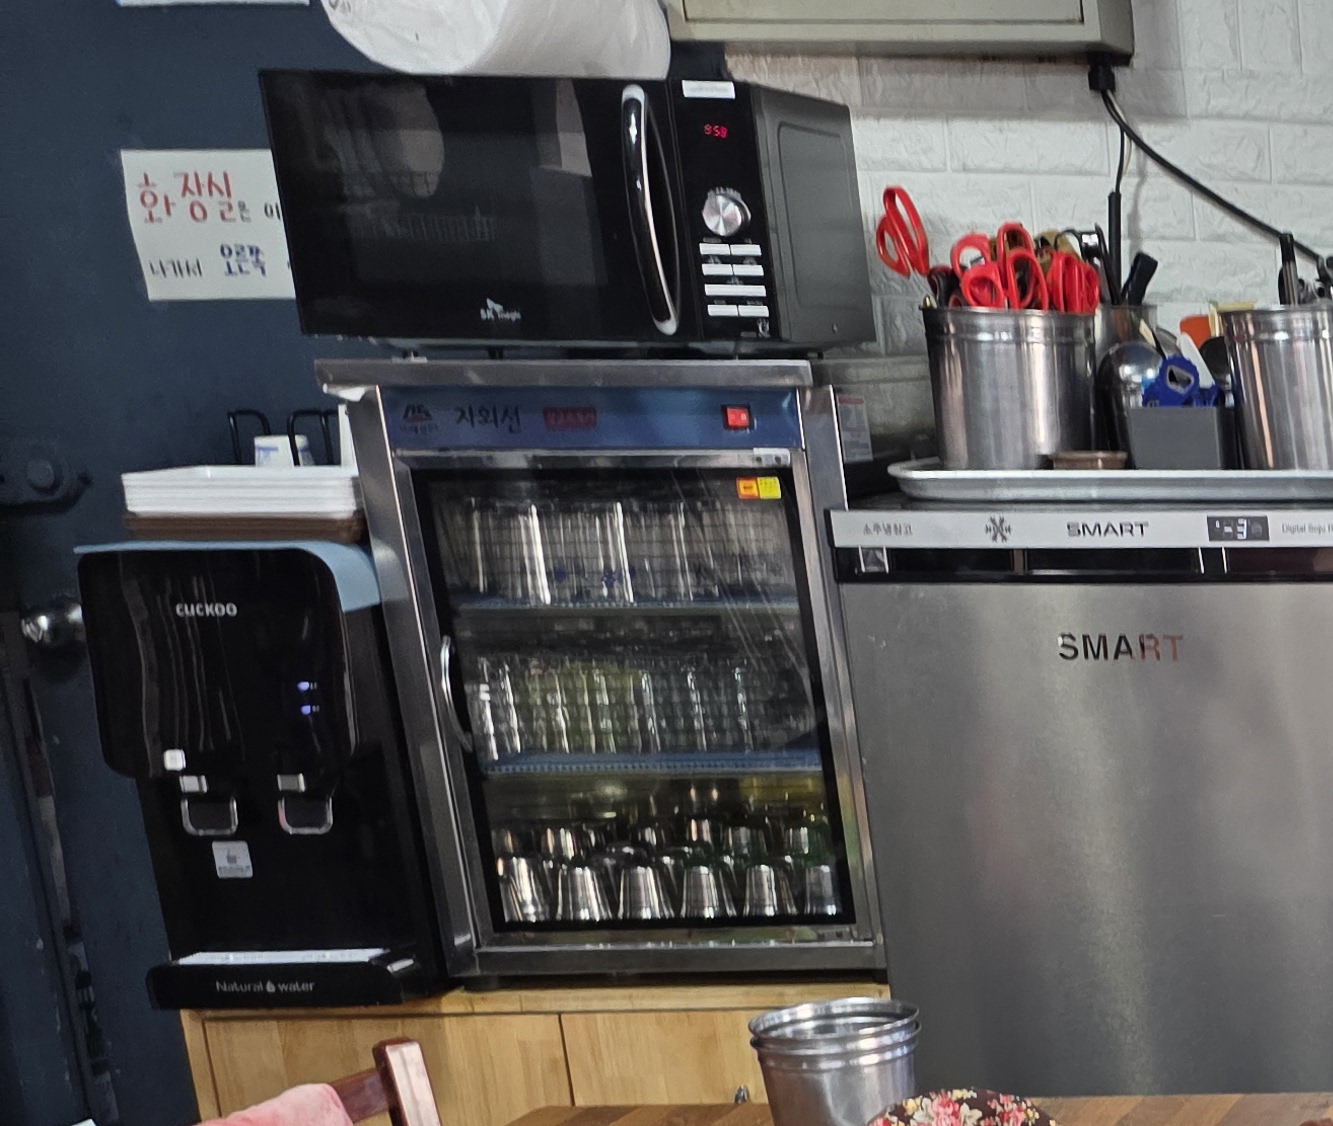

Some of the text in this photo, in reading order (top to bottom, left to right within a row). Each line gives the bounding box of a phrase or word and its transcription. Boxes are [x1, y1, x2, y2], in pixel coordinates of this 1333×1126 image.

[1066, 521, 1149, 538] SMART
[1281, 522, 1305, 534] Digital
[176, 603, 238, 617] CUCKOO
[1058, 632, 1184, 662] SMART
[216, 980, 315, 993] Natural water
